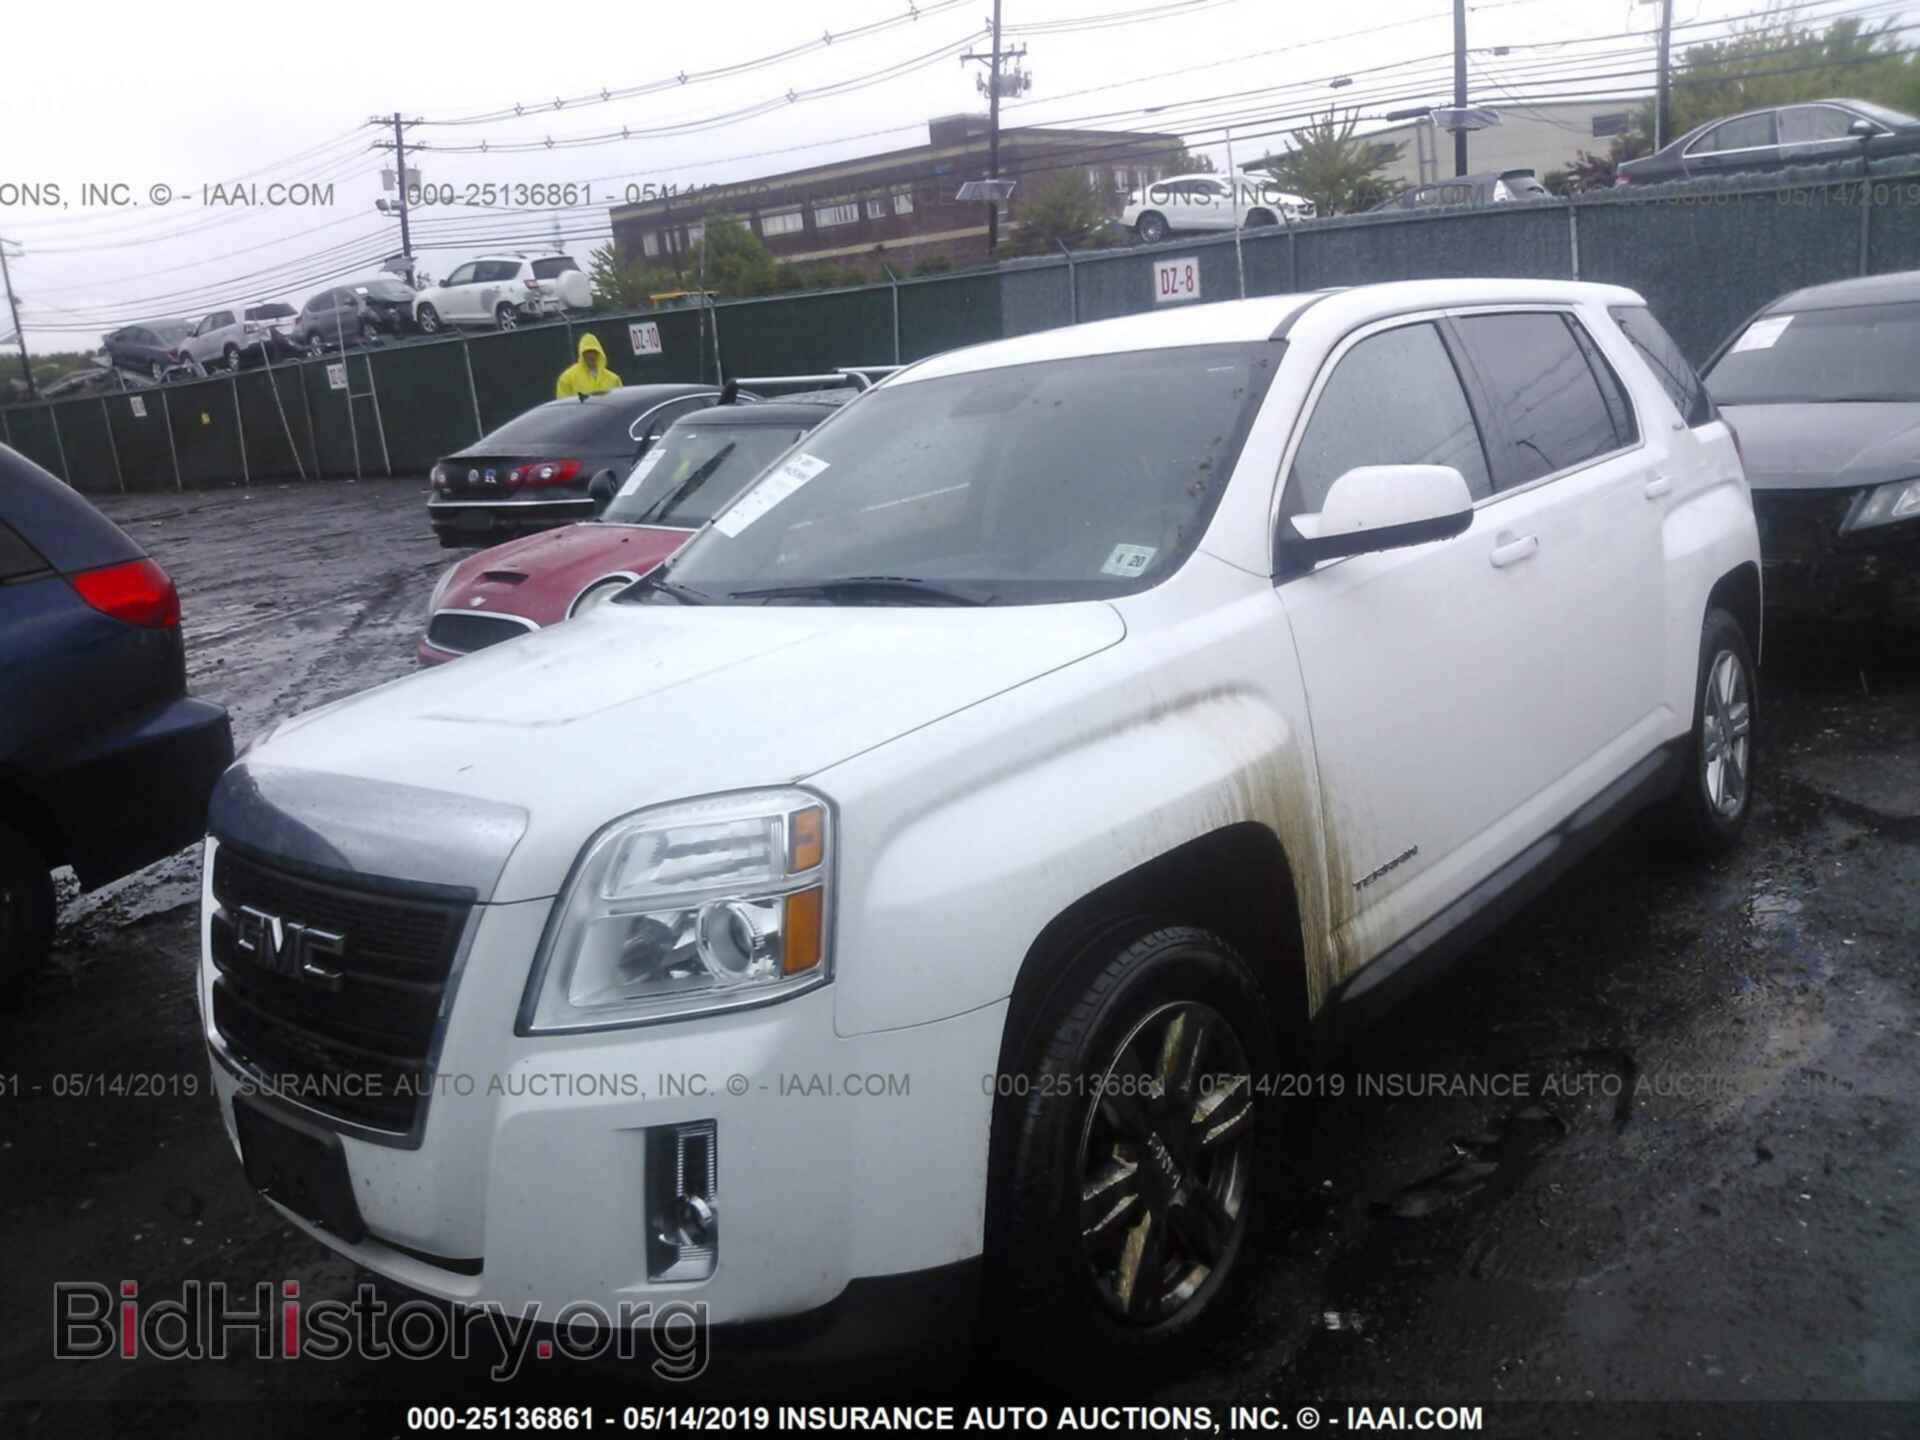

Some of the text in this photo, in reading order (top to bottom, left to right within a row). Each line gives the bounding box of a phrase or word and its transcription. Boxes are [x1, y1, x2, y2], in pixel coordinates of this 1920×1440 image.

[1160, 265, 1194, 295] DZ-8
[632, 327, 659, 350] DZ-10
[238, 904, 345, 979] GMC
